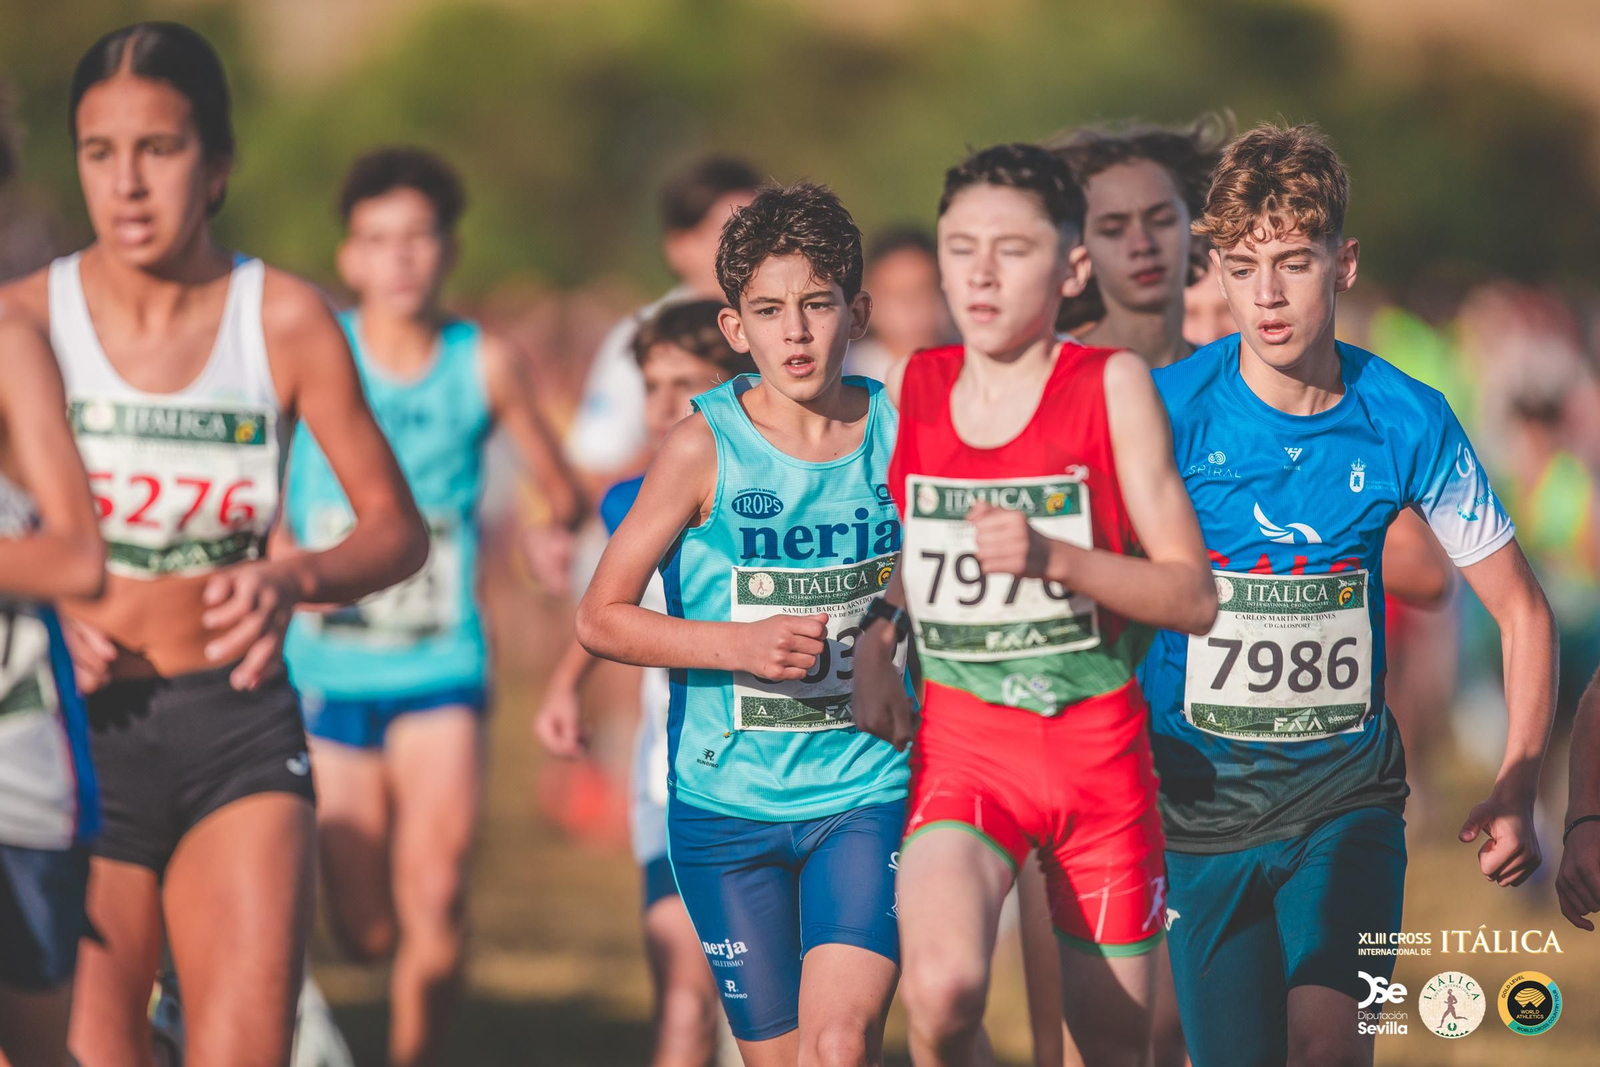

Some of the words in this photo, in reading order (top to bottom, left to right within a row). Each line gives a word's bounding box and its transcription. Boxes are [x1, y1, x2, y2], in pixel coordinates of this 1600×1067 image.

[1189, 464, 1241, 478] SPIRAL
[734, 494, 781, 514] TROPS
[738, 507, 902, 565] nerja
[787, 570, 869, 595] ITÁLICA
[1246, 581, 1329, 603] ITÁLICA
[782, 606, 815, 614] SAMUEL
[816, 603, 846, 613] BARCIA
[1235, 613, 1267, 621] CARLOS
[1268, 612, 1299, 622] MARTÍN
[1300, 613, 1336, 622] BRETONES
[1207, 637, 1359, 693] 7986
[702, 938, 749, 960] nerja
